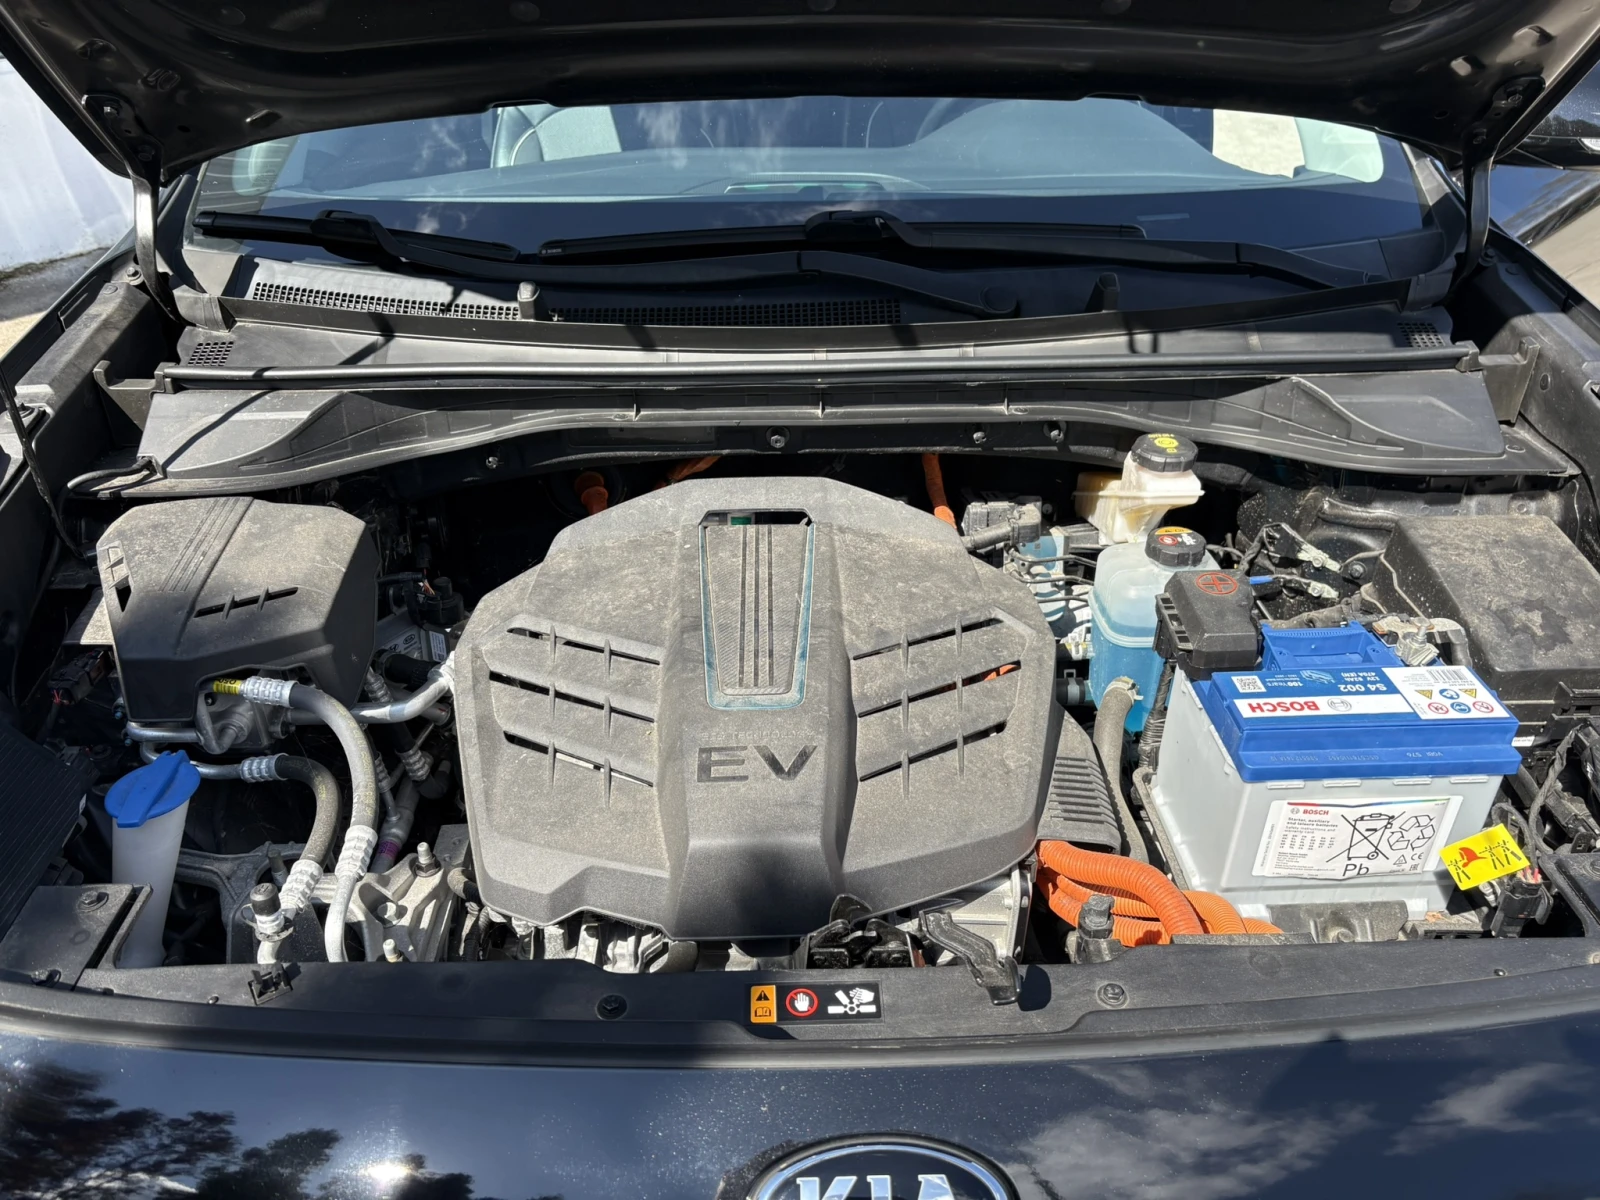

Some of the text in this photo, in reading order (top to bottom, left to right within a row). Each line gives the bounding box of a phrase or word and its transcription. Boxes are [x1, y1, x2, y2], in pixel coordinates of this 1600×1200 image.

[1337, 683, 1387, 692] S4 002
[1247, 700, 1320, 713] BOSCH
[697, 745, 818, 782] EV
[1342, 863, 1370, 877] Pb
